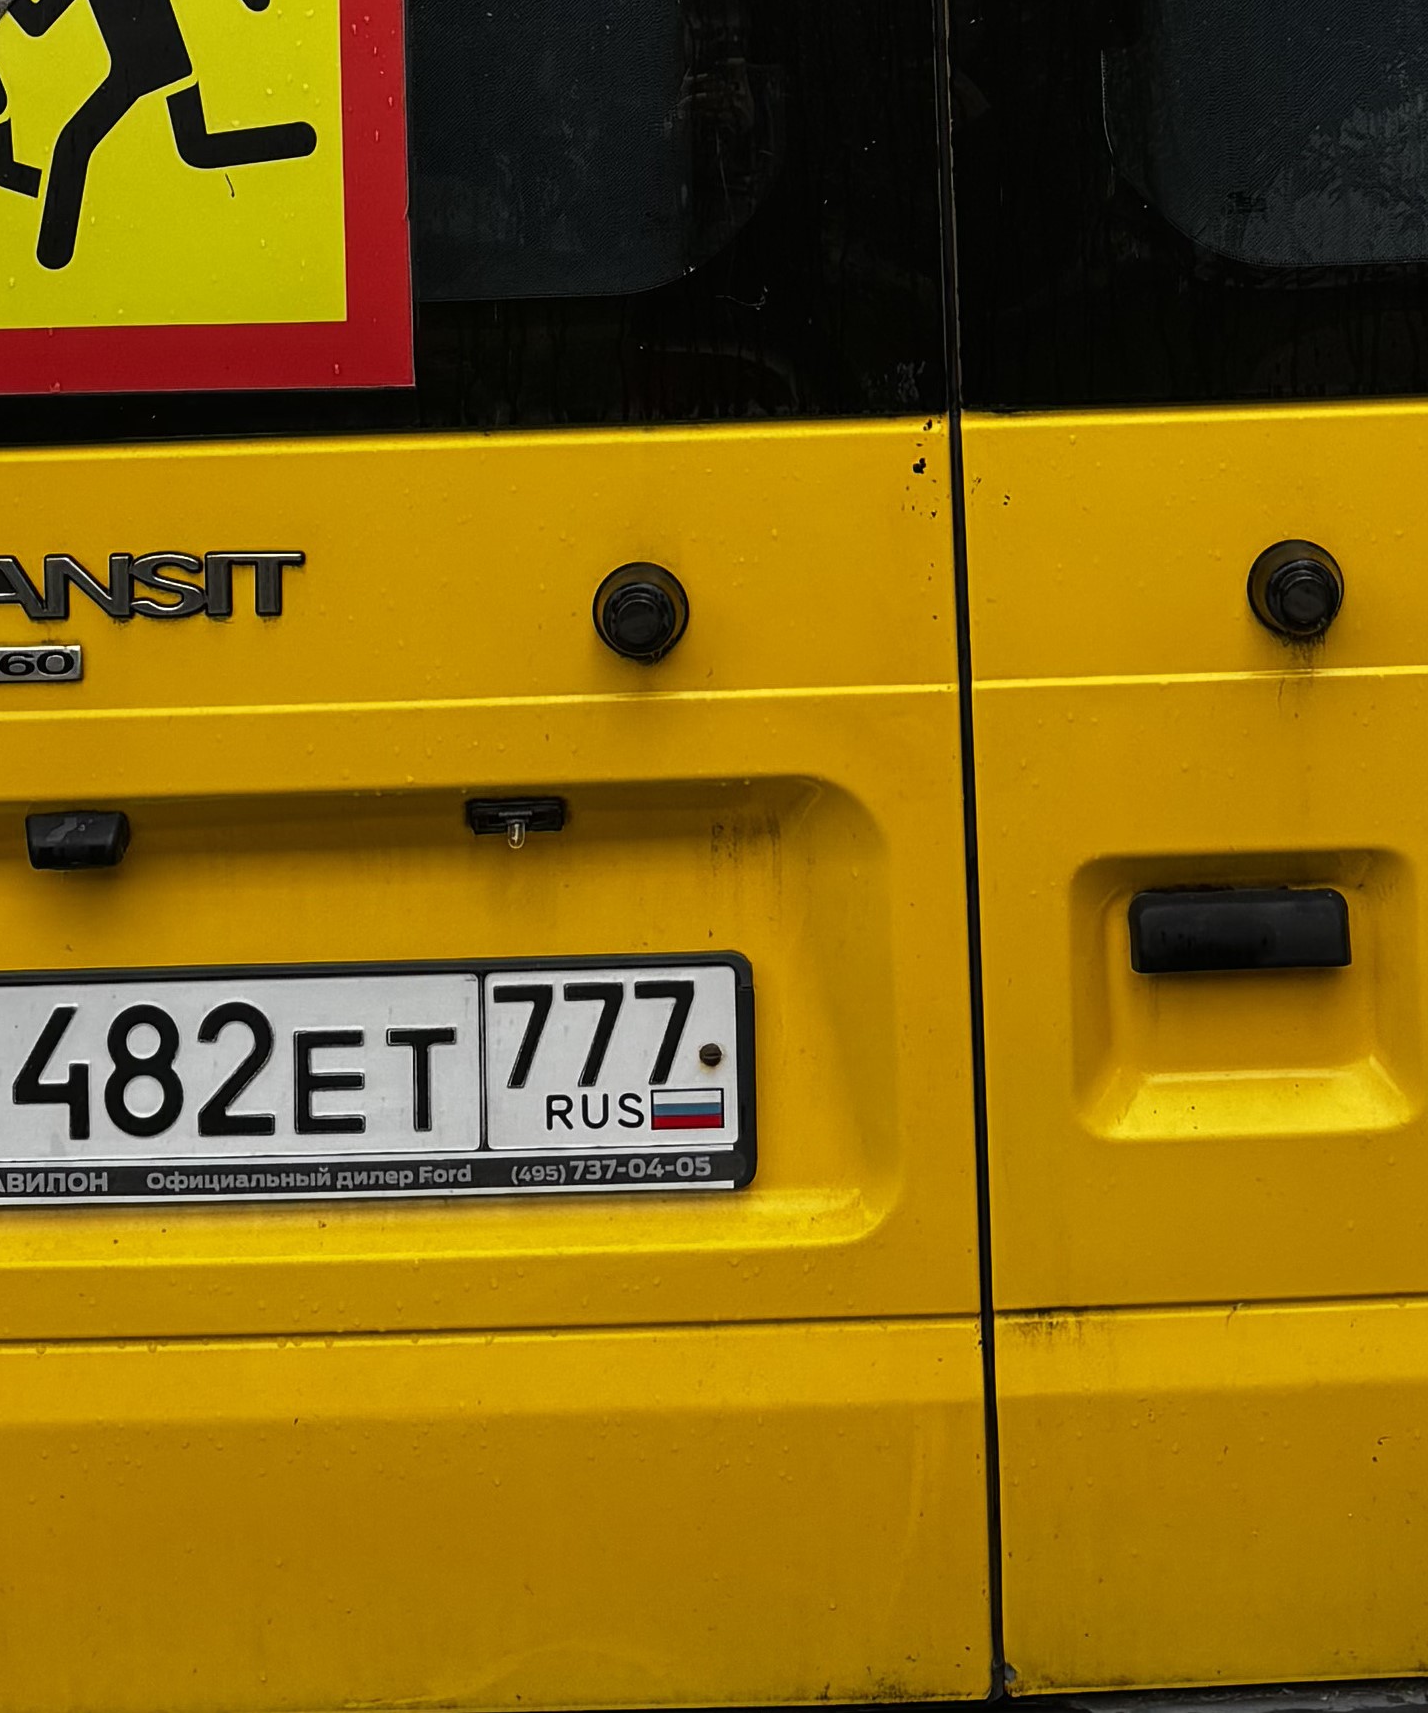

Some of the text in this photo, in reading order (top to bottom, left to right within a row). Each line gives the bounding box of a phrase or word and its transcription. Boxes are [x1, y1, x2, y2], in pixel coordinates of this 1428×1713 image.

[492, 979, 697, 1090] 777
[545, 1092, 644, 1131] RUS
[146, 1164, 472, 1193] Официальный дилер Ford
[510, 1156, 712, 1185] (495) 737-04-05
